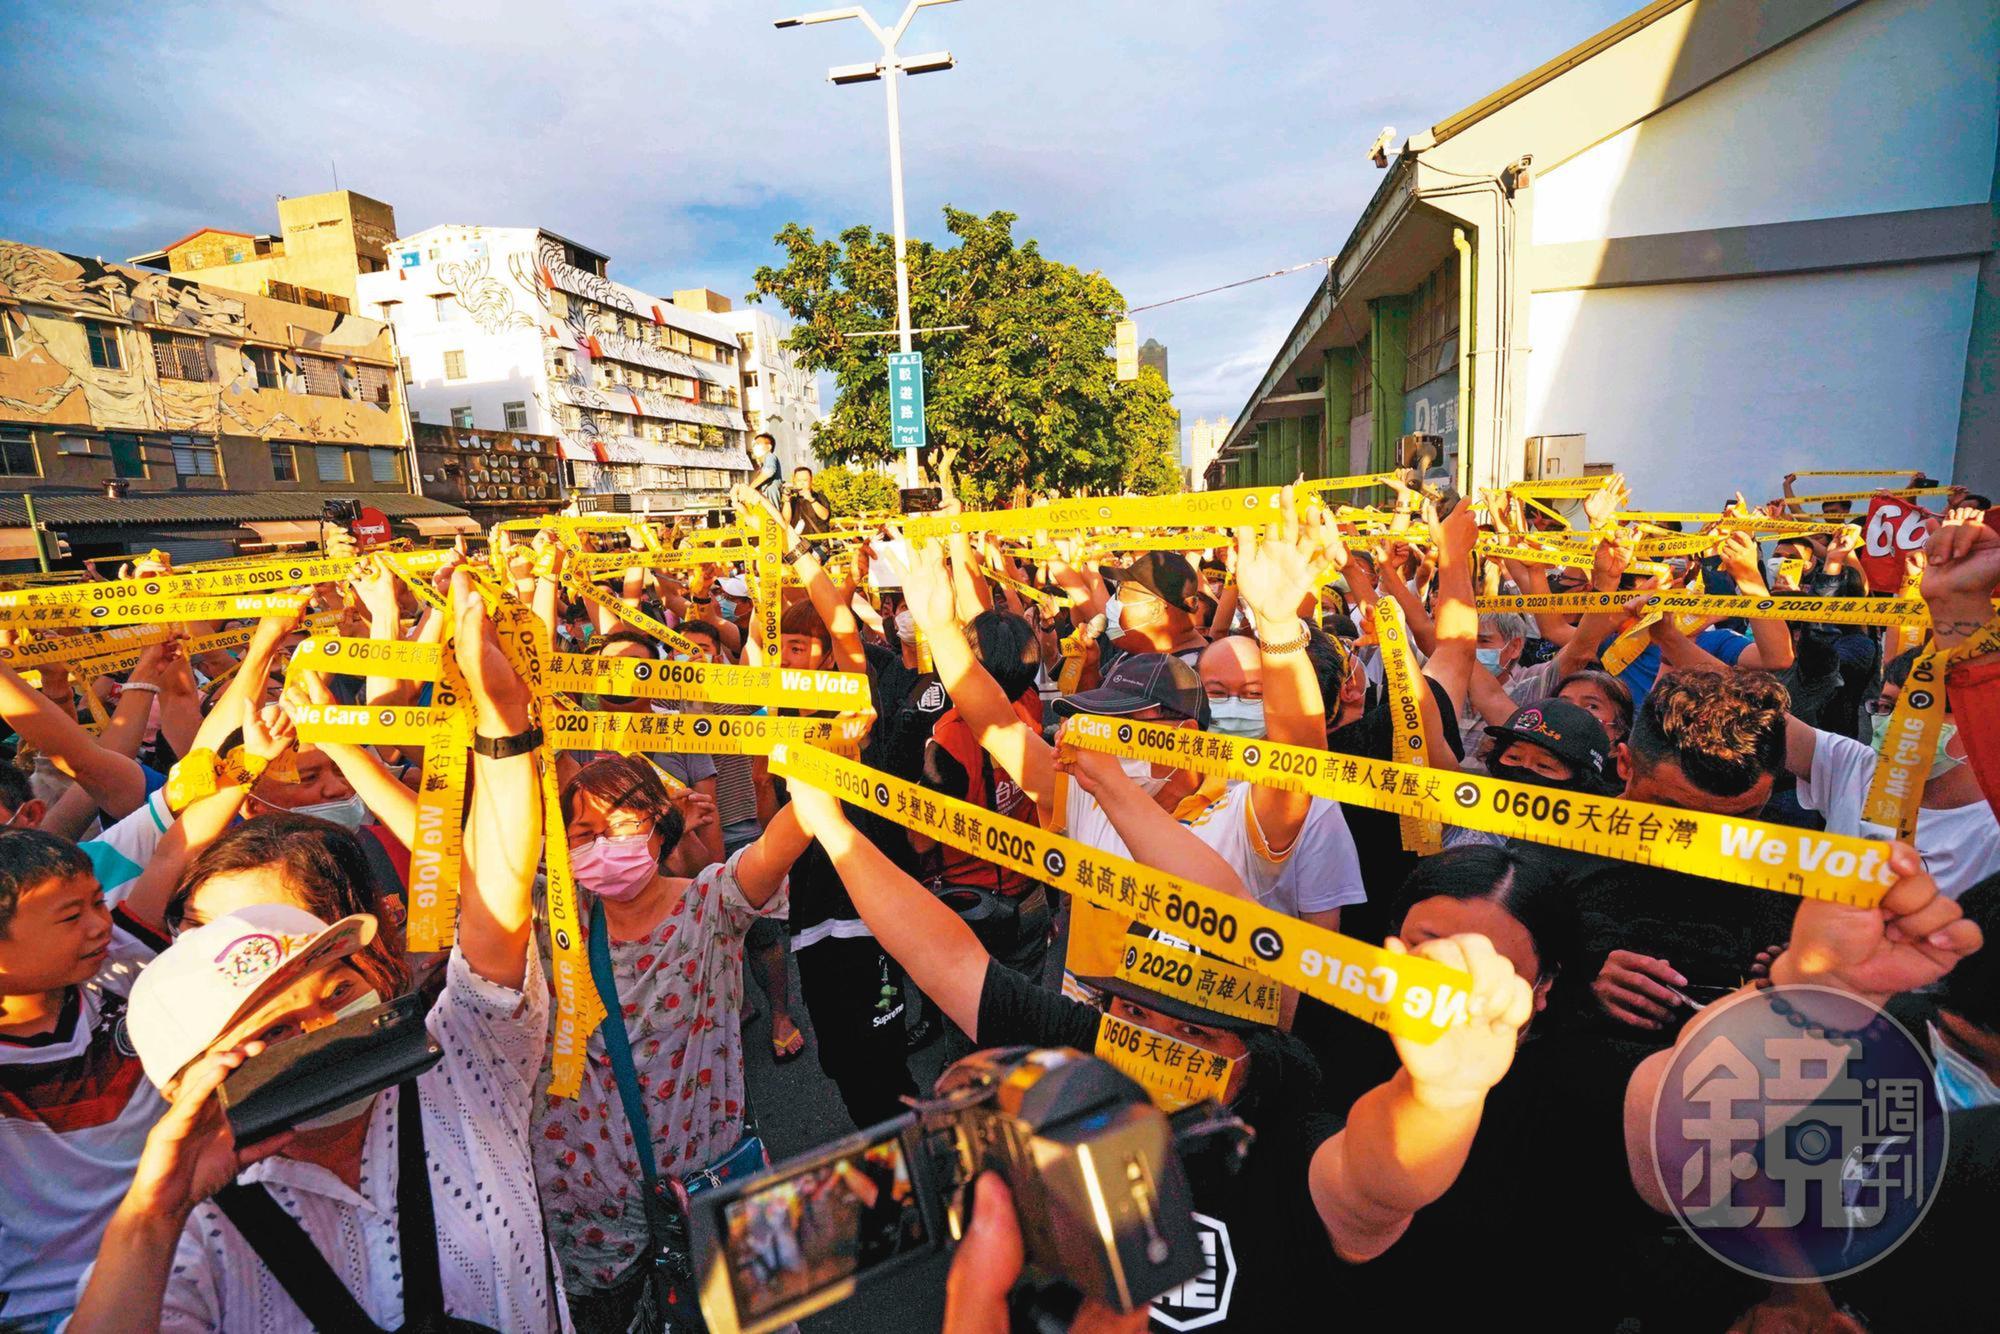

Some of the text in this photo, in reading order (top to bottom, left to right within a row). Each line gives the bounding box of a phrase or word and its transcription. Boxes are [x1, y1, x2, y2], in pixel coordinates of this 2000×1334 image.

[117, 603, 165, 617] 0606
[169, 600, 228, 615] 天佑台灣
[235, 598, 263, 611] We
[265, 595, 301, 609] Vote
[1527, 597, 1548, 607] 2020
[1664, 598, 1701, 607] 0606
[1777, 601, 1823, 612] 2020
[1823, 601, 1926, 615] 高雄人寫歷史
[19, 642, 59, 657] 0606
[348, 643, 391, 660] 0606
[659, 667, 706, 685] 0606
[711, 670, 774, 688] 天佑台灣
[781, 671, 812, 691] We
[815, 674, 859, 695] Vote
[293, 707, 321, 725] We
[324, 707, 370, 726] Care
[592, 714, 686, 736] 高雄人寫歷史
[719, 718, 766, 738] 0606
[770, 720, 833, 741] 天佑台灣
[1078, 715, 1112, 739] Care
[1137, 731, 1176, 751] 0606
[1177, 733, 1234, 762] 光復高雄
[1268, 750, 1318, 778] 2020
[1322, 756, 1441, 803] 高雄人寫歷史
[1493, 788, 1571, 826] 0606
[1577, 802, 1699, 850] 天佑台灣
[1720, 823, 1788, 865] We
[558, 959, 574, 1015] Care
[1139, 951, 1194, 987] 2020
[1195, 967, 1268, 1012] 高雄人寫
[556, 1017, 576, 1056] We
[1103, 1021, 1229, 1083] 0606 天佑台灣
